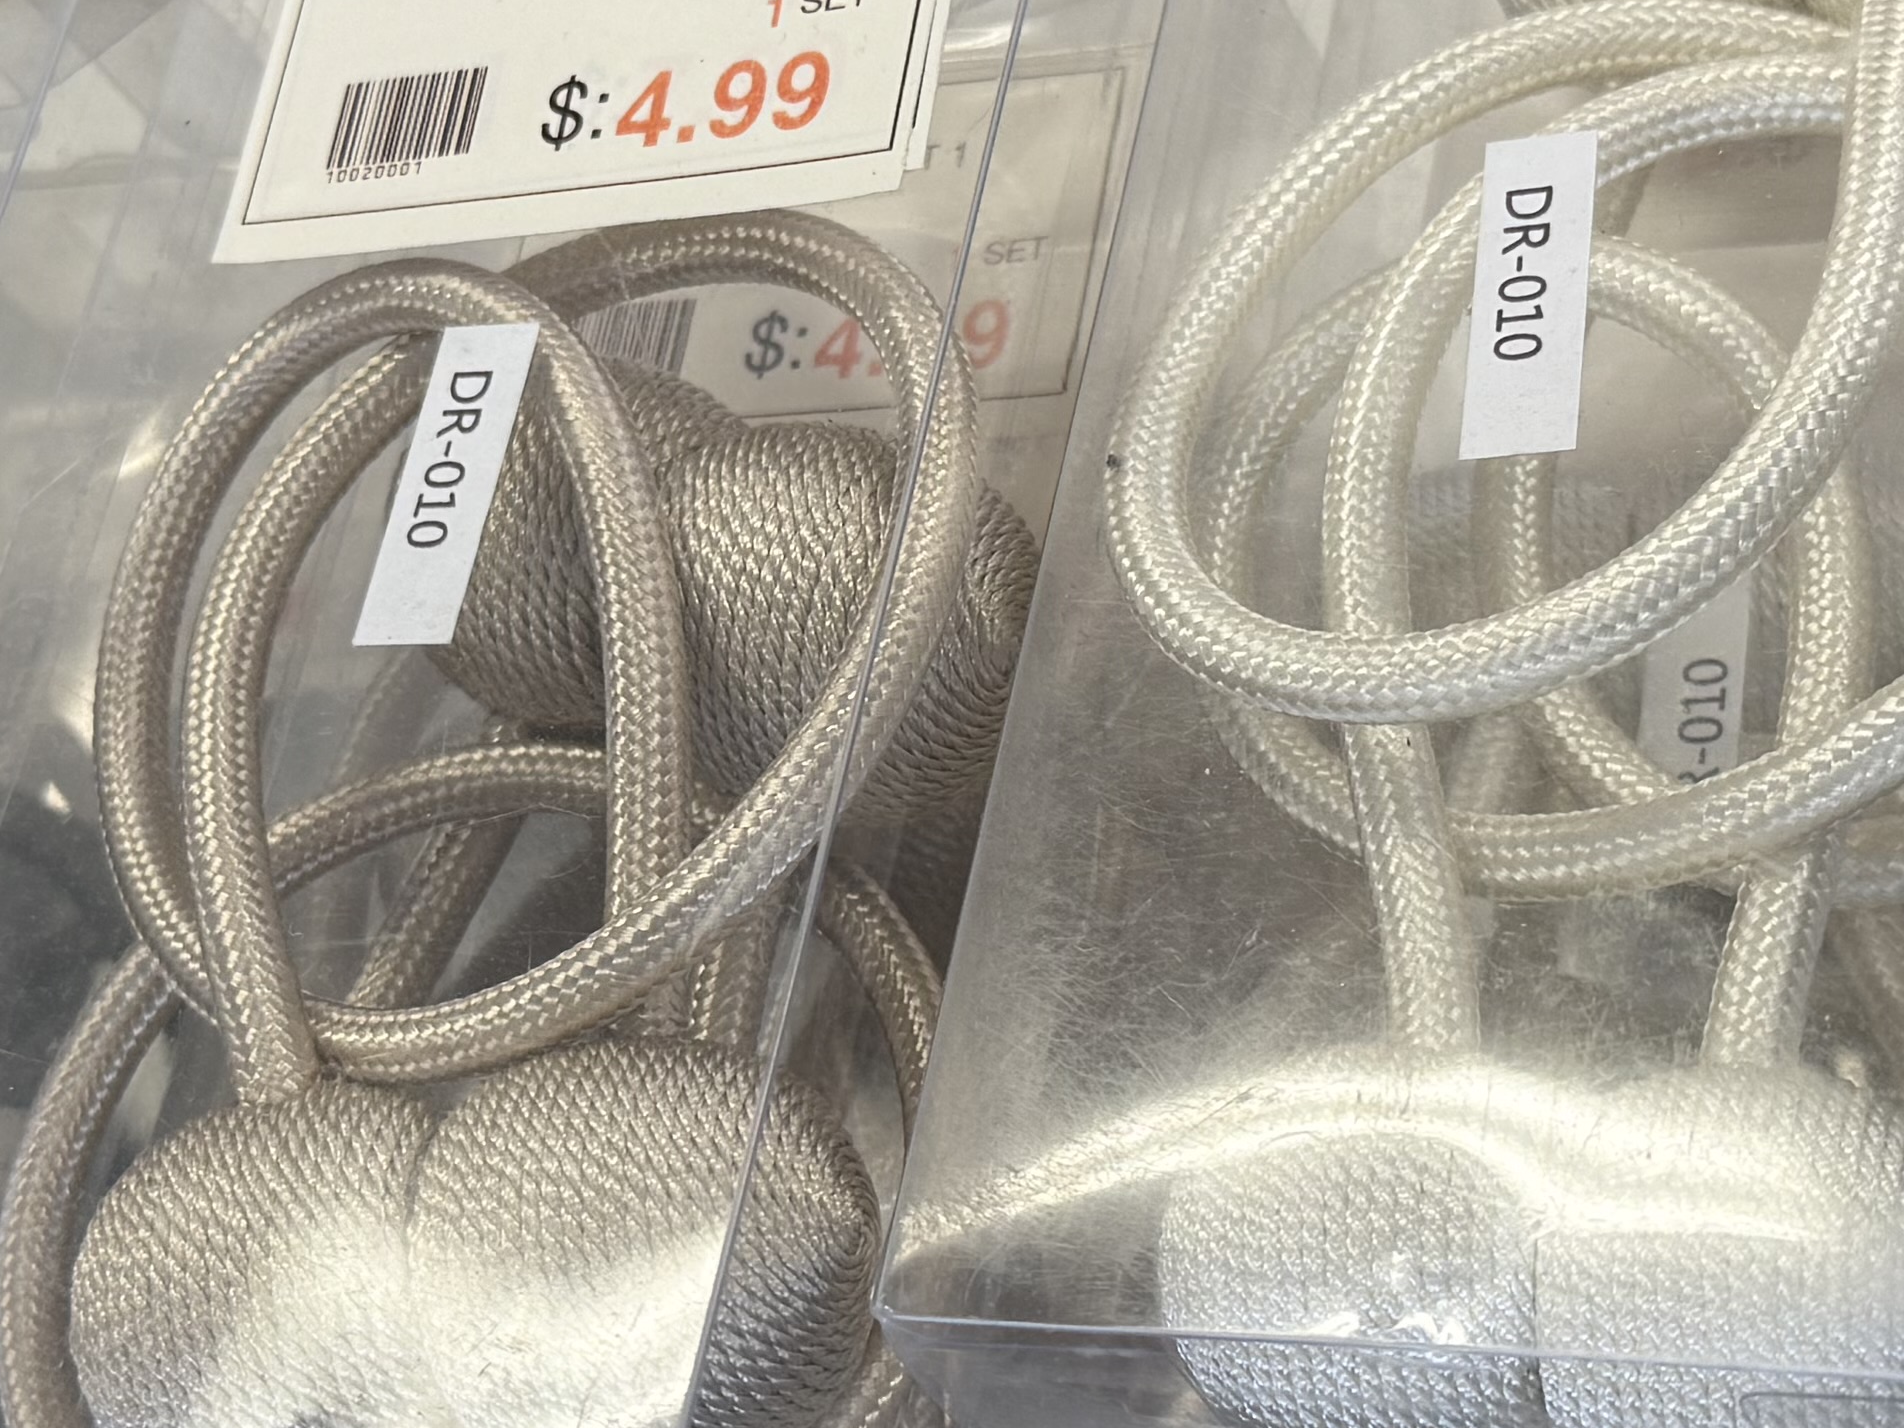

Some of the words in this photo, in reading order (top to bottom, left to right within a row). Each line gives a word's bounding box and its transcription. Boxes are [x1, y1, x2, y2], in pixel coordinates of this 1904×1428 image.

[325, 160, 423, 184] 10020001
[982, 235, 1049, 267] SET
[1492, 184, 1554, 362] DR-010
[406, 369, 494, 549] DR-010
